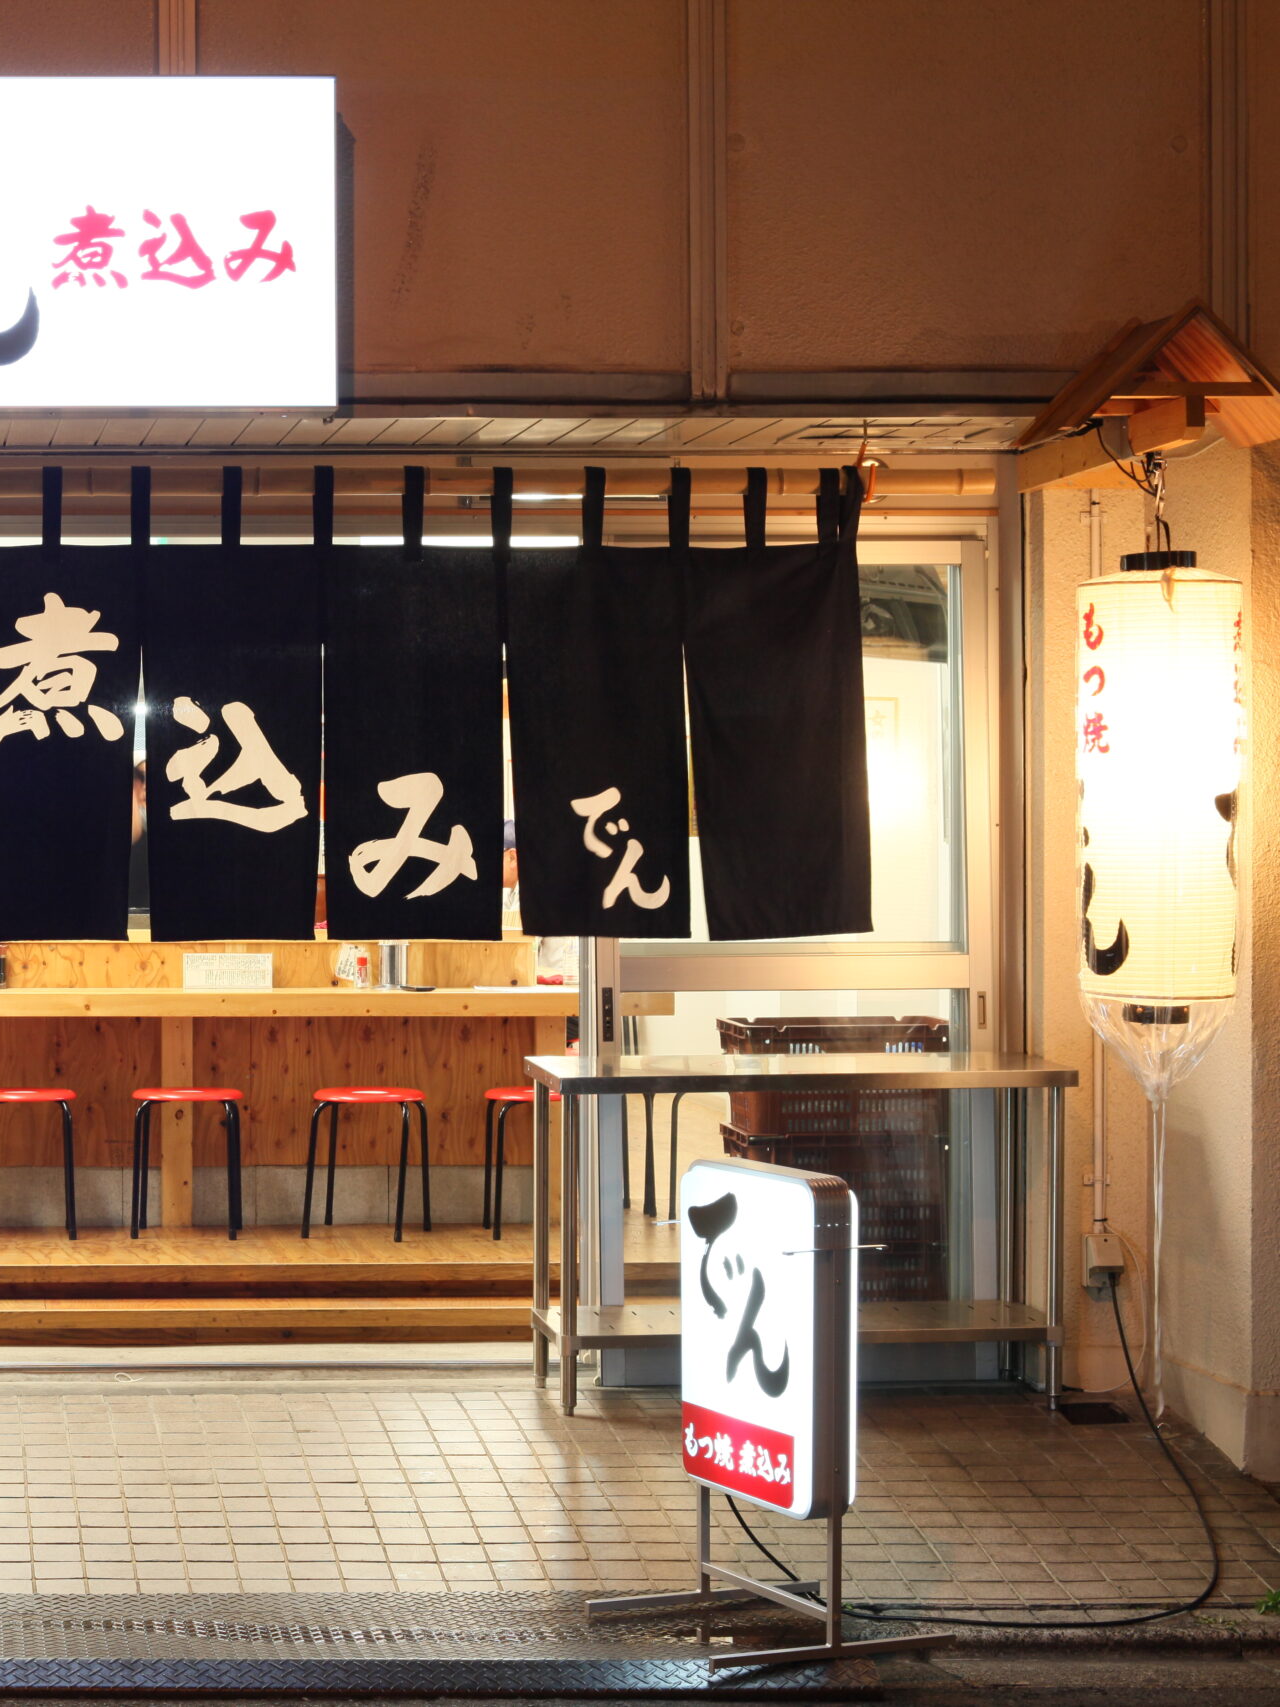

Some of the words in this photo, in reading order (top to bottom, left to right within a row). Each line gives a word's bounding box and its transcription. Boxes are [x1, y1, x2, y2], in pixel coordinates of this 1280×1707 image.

[51, 204, 297, 290] 煮込み
[1083, 602, 1110, 754] もつ焼
[570, 787, 671, 910] でん
[687, 1192, 790, 1398] でん
[684, 1422, 734, 1471] もつ焼
[739, 1440, 792, 1485] 煮込み
